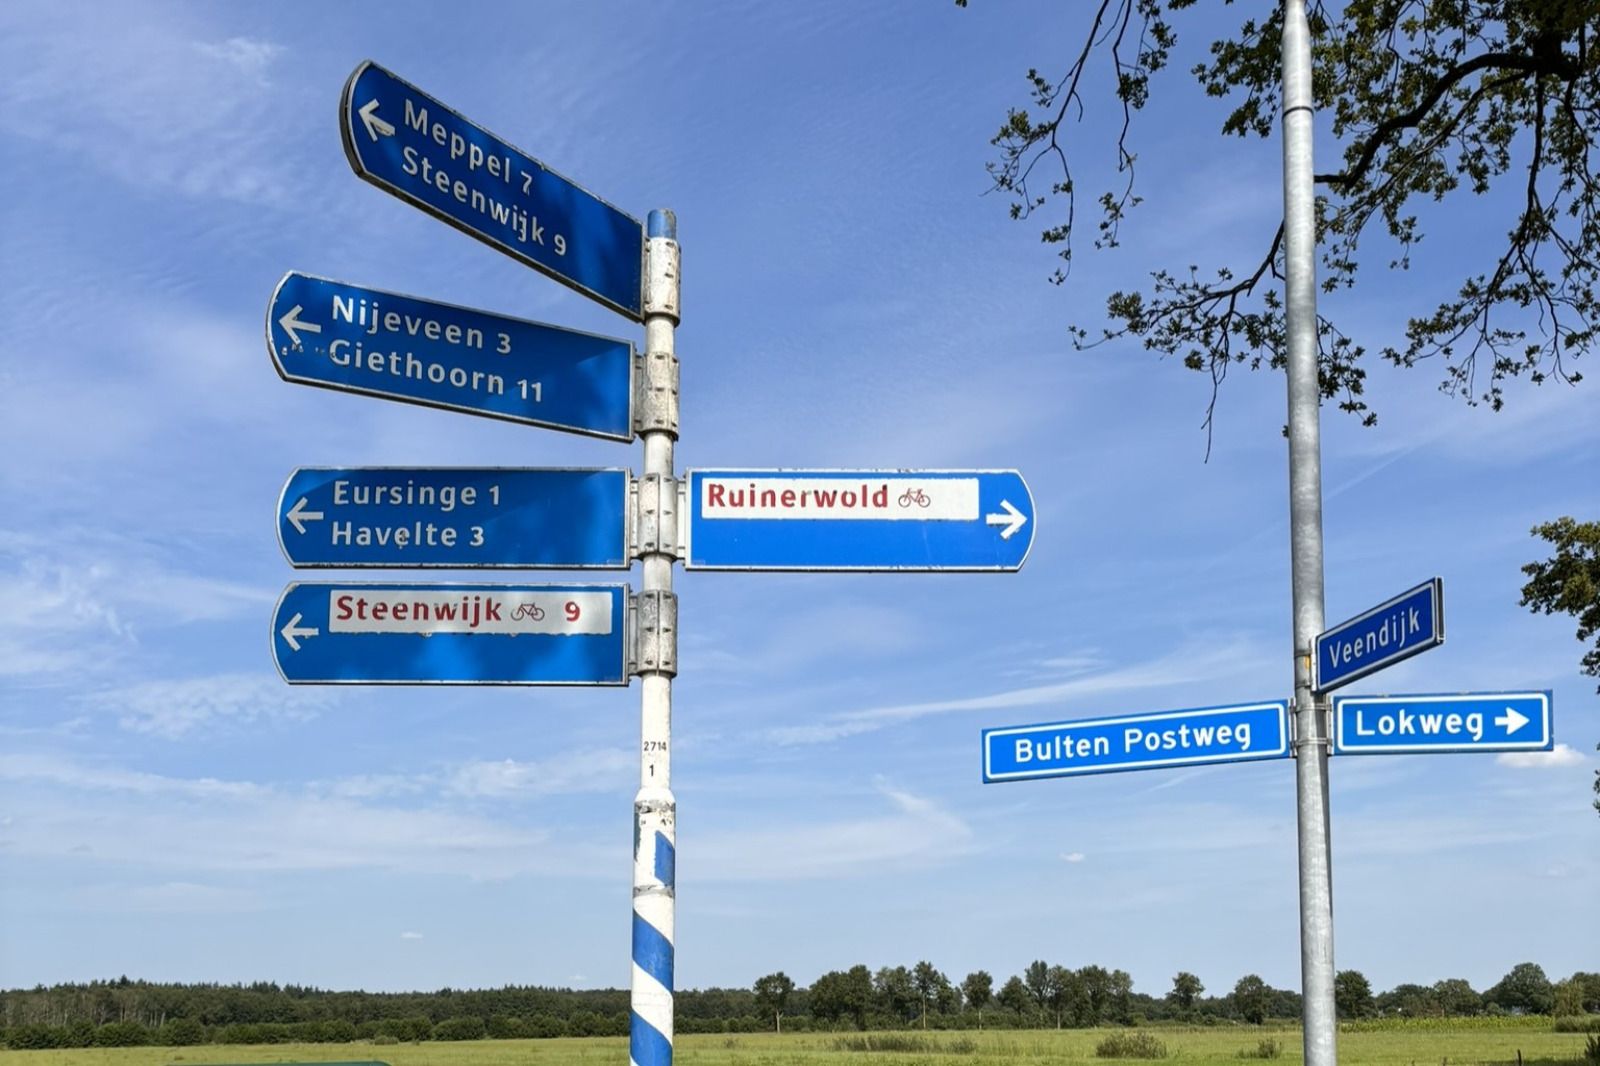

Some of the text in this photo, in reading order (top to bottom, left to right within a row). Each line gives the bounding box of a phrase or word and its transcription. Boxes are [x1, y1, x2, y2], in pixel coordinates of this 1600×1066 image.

[404, 99, 533, 196] Meppel 7
[402, 146, 567, 256] Steenwijk 9
[332, 295, 512, 354] Nijeveen 3
[329, 339, 542, 402] Giethoorn 11
[333, 480, 500, 512] Eursinge 1
[708, 483, 889, 508] Ruinerwold
[332, 521, 485, 548] Havelte 3
[336, 596, 581, 627] Steenwijk 9
[1328, 608, 1421, 669] Veendijk
[1356, 710, 1484, 741] Lokweg
[643, 741, 667, 751] 2714
[1015, 720, 1252, 764] Bulten Postweg
[649, 764, 655, 777] 1
